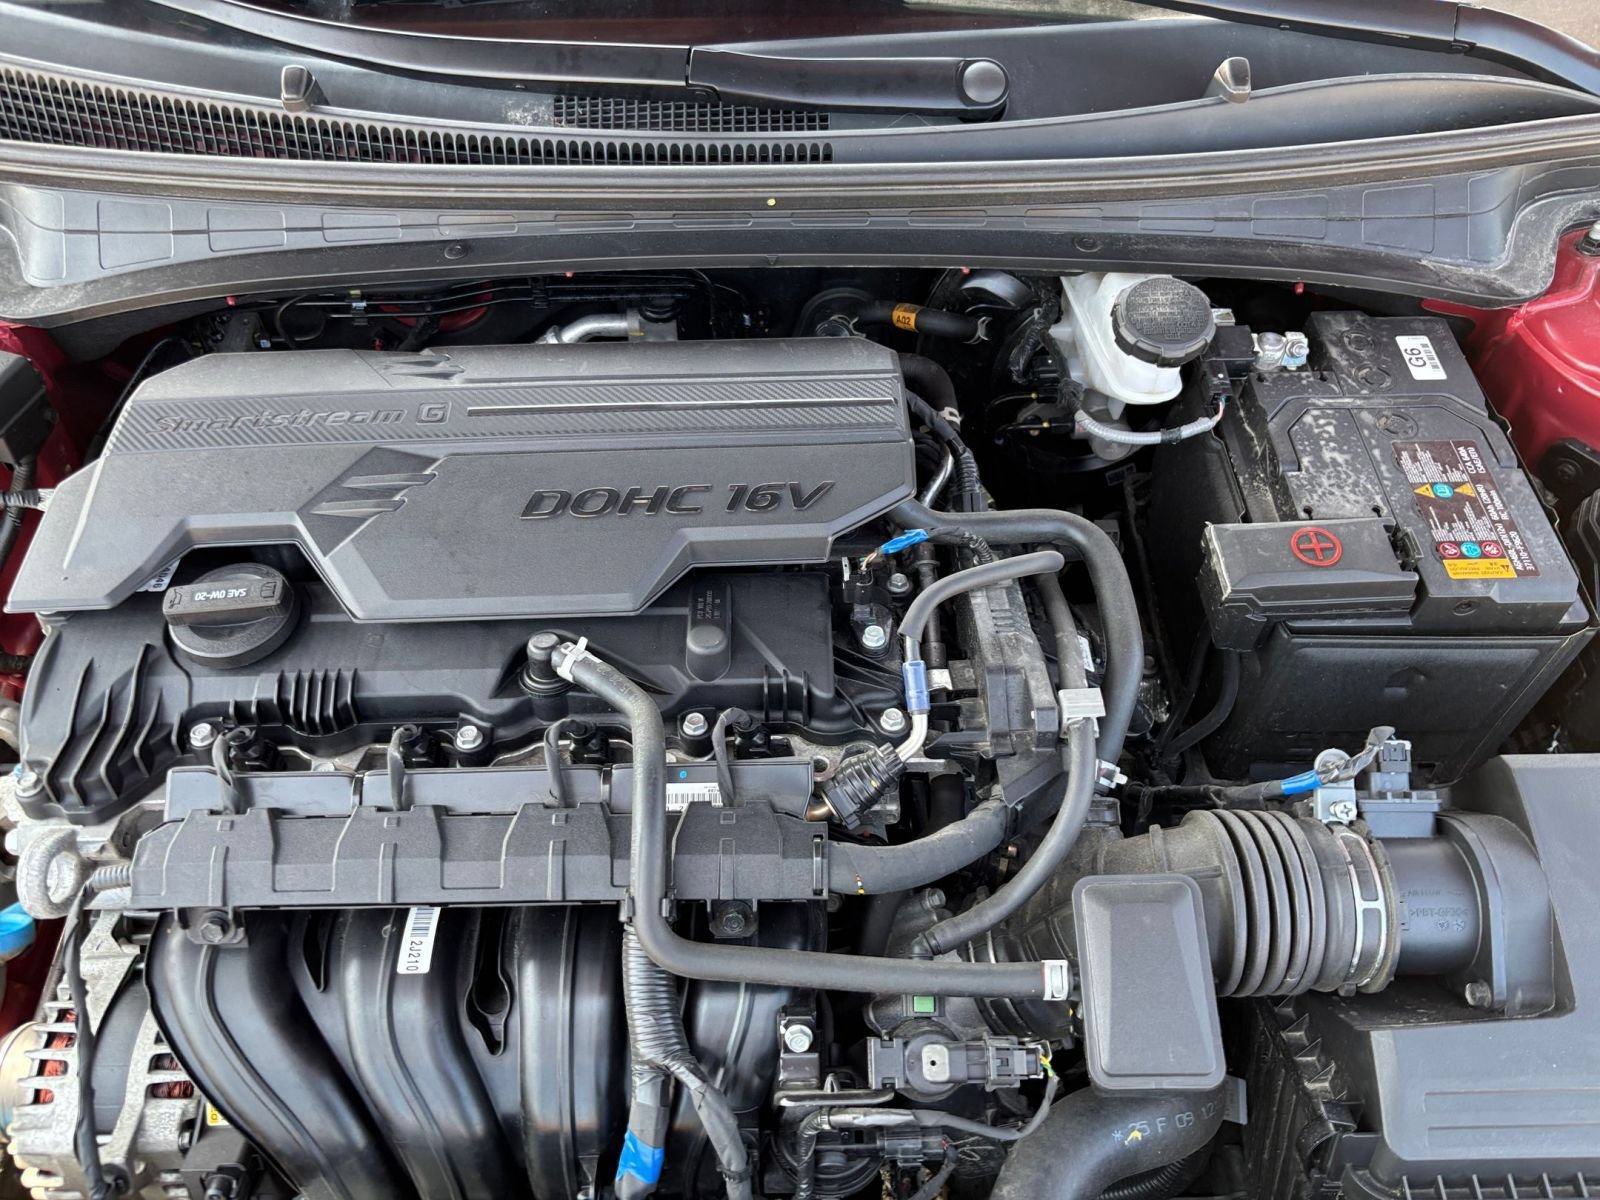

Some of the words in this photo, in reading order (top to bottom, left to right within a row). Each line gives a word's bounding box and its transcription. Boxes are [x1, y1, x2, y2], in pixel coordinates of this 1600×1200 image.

[1404, 348, 1427, 367] G6
[146, 408, 407, 434] Smartstream
[419, 403, 448, 423] G
[1465, 461, 1476, 474] CCA
[520, 484, 712, 519] DOHC
[725, 480, 835, 512] 16V
[195, 590, 226, 601] 0W-20
[227, 588, 247, 598] SAE
[406, 940, 423, 972] 2J210
[1156, 1117, 1167, 1133] F
